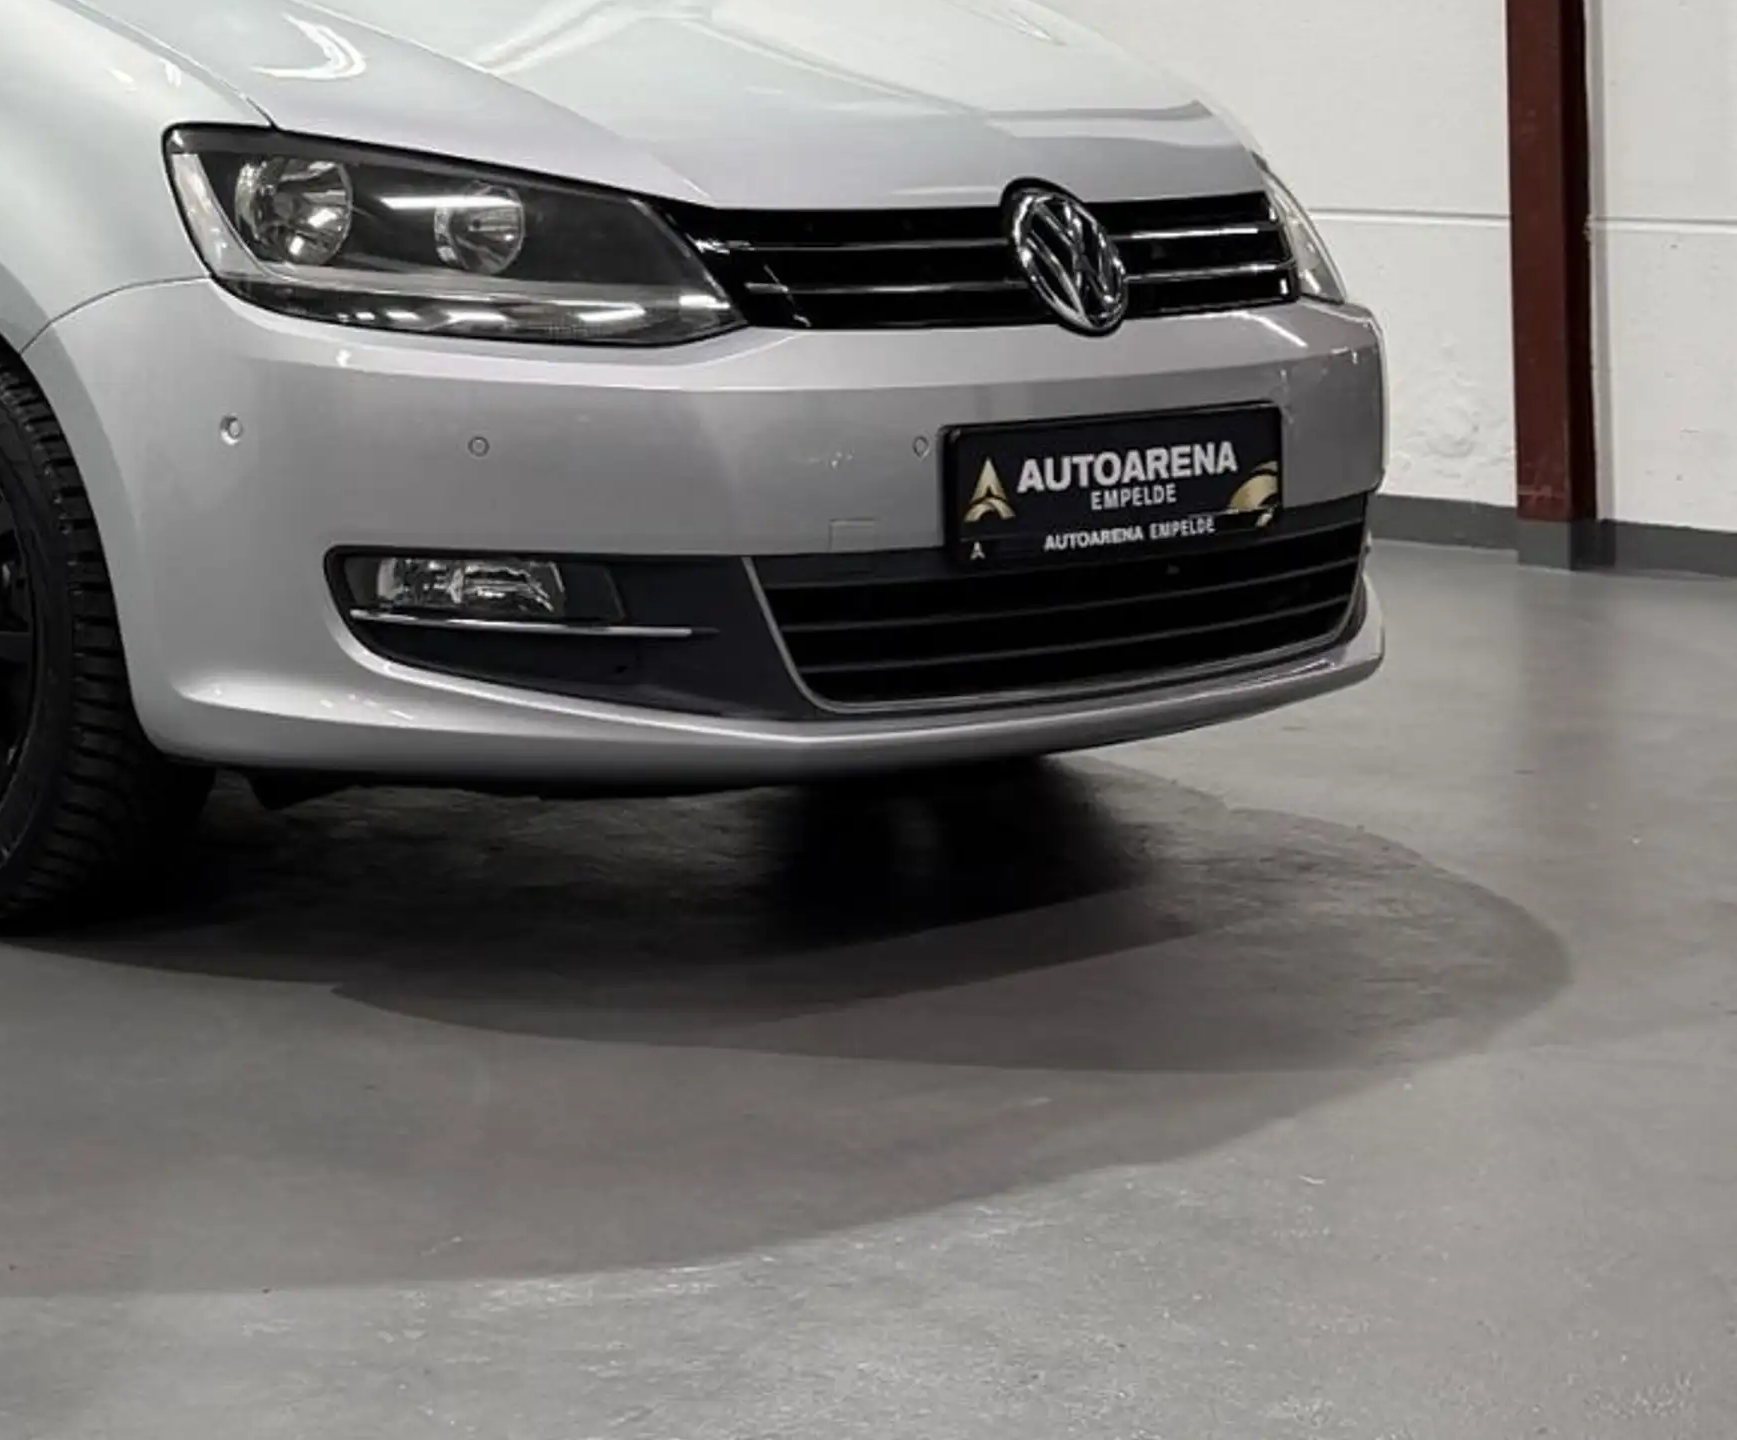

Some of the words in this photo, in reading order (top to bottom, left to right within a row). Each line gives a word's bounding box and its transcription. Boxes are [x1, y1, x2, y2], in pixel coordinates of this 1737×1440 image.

[1016, 440, 1239, 494] AUTOARENA
[1090, 483, 1178, 511] EMPELDE
[1043, 525, 1144, 552] AUTOARENA
[1149, 515, 1216, 540] EMPELDE
